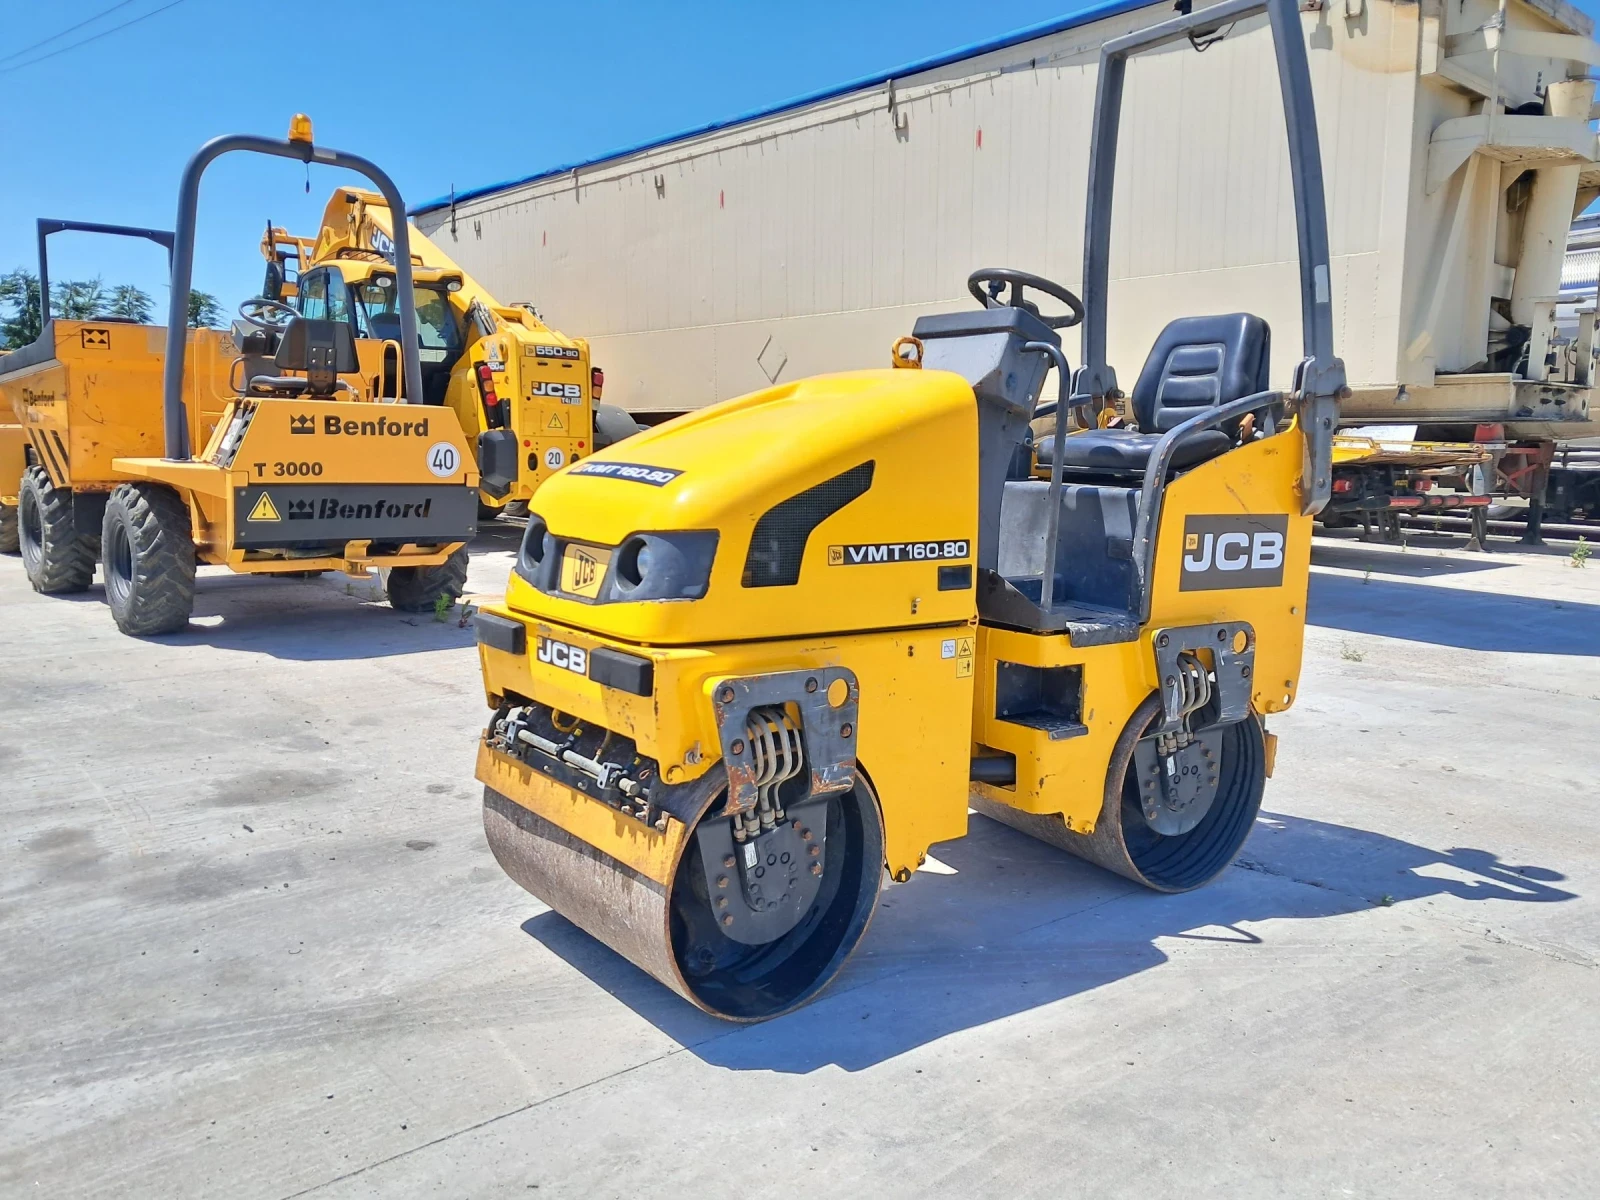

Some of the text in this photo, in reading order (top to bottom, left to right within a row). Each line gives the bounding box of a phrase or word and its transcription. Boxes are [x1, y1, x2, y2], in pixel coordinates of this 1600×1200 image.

[536, 345, 578, 357] 550-80
[533, 383, 580, 397] JCB
[324, 415, 429, 437] Benford
[432, 448, 454, 471] 40
[548, 452, 561, 465] 20
[254, 462, 323, 477] T 3000
[318, 498, 432, 519] Benford
[1184, 532, 1284, 572] JCB
[574, 554, 595, 587] JCB
[538, 639, 586, 674] JCB
